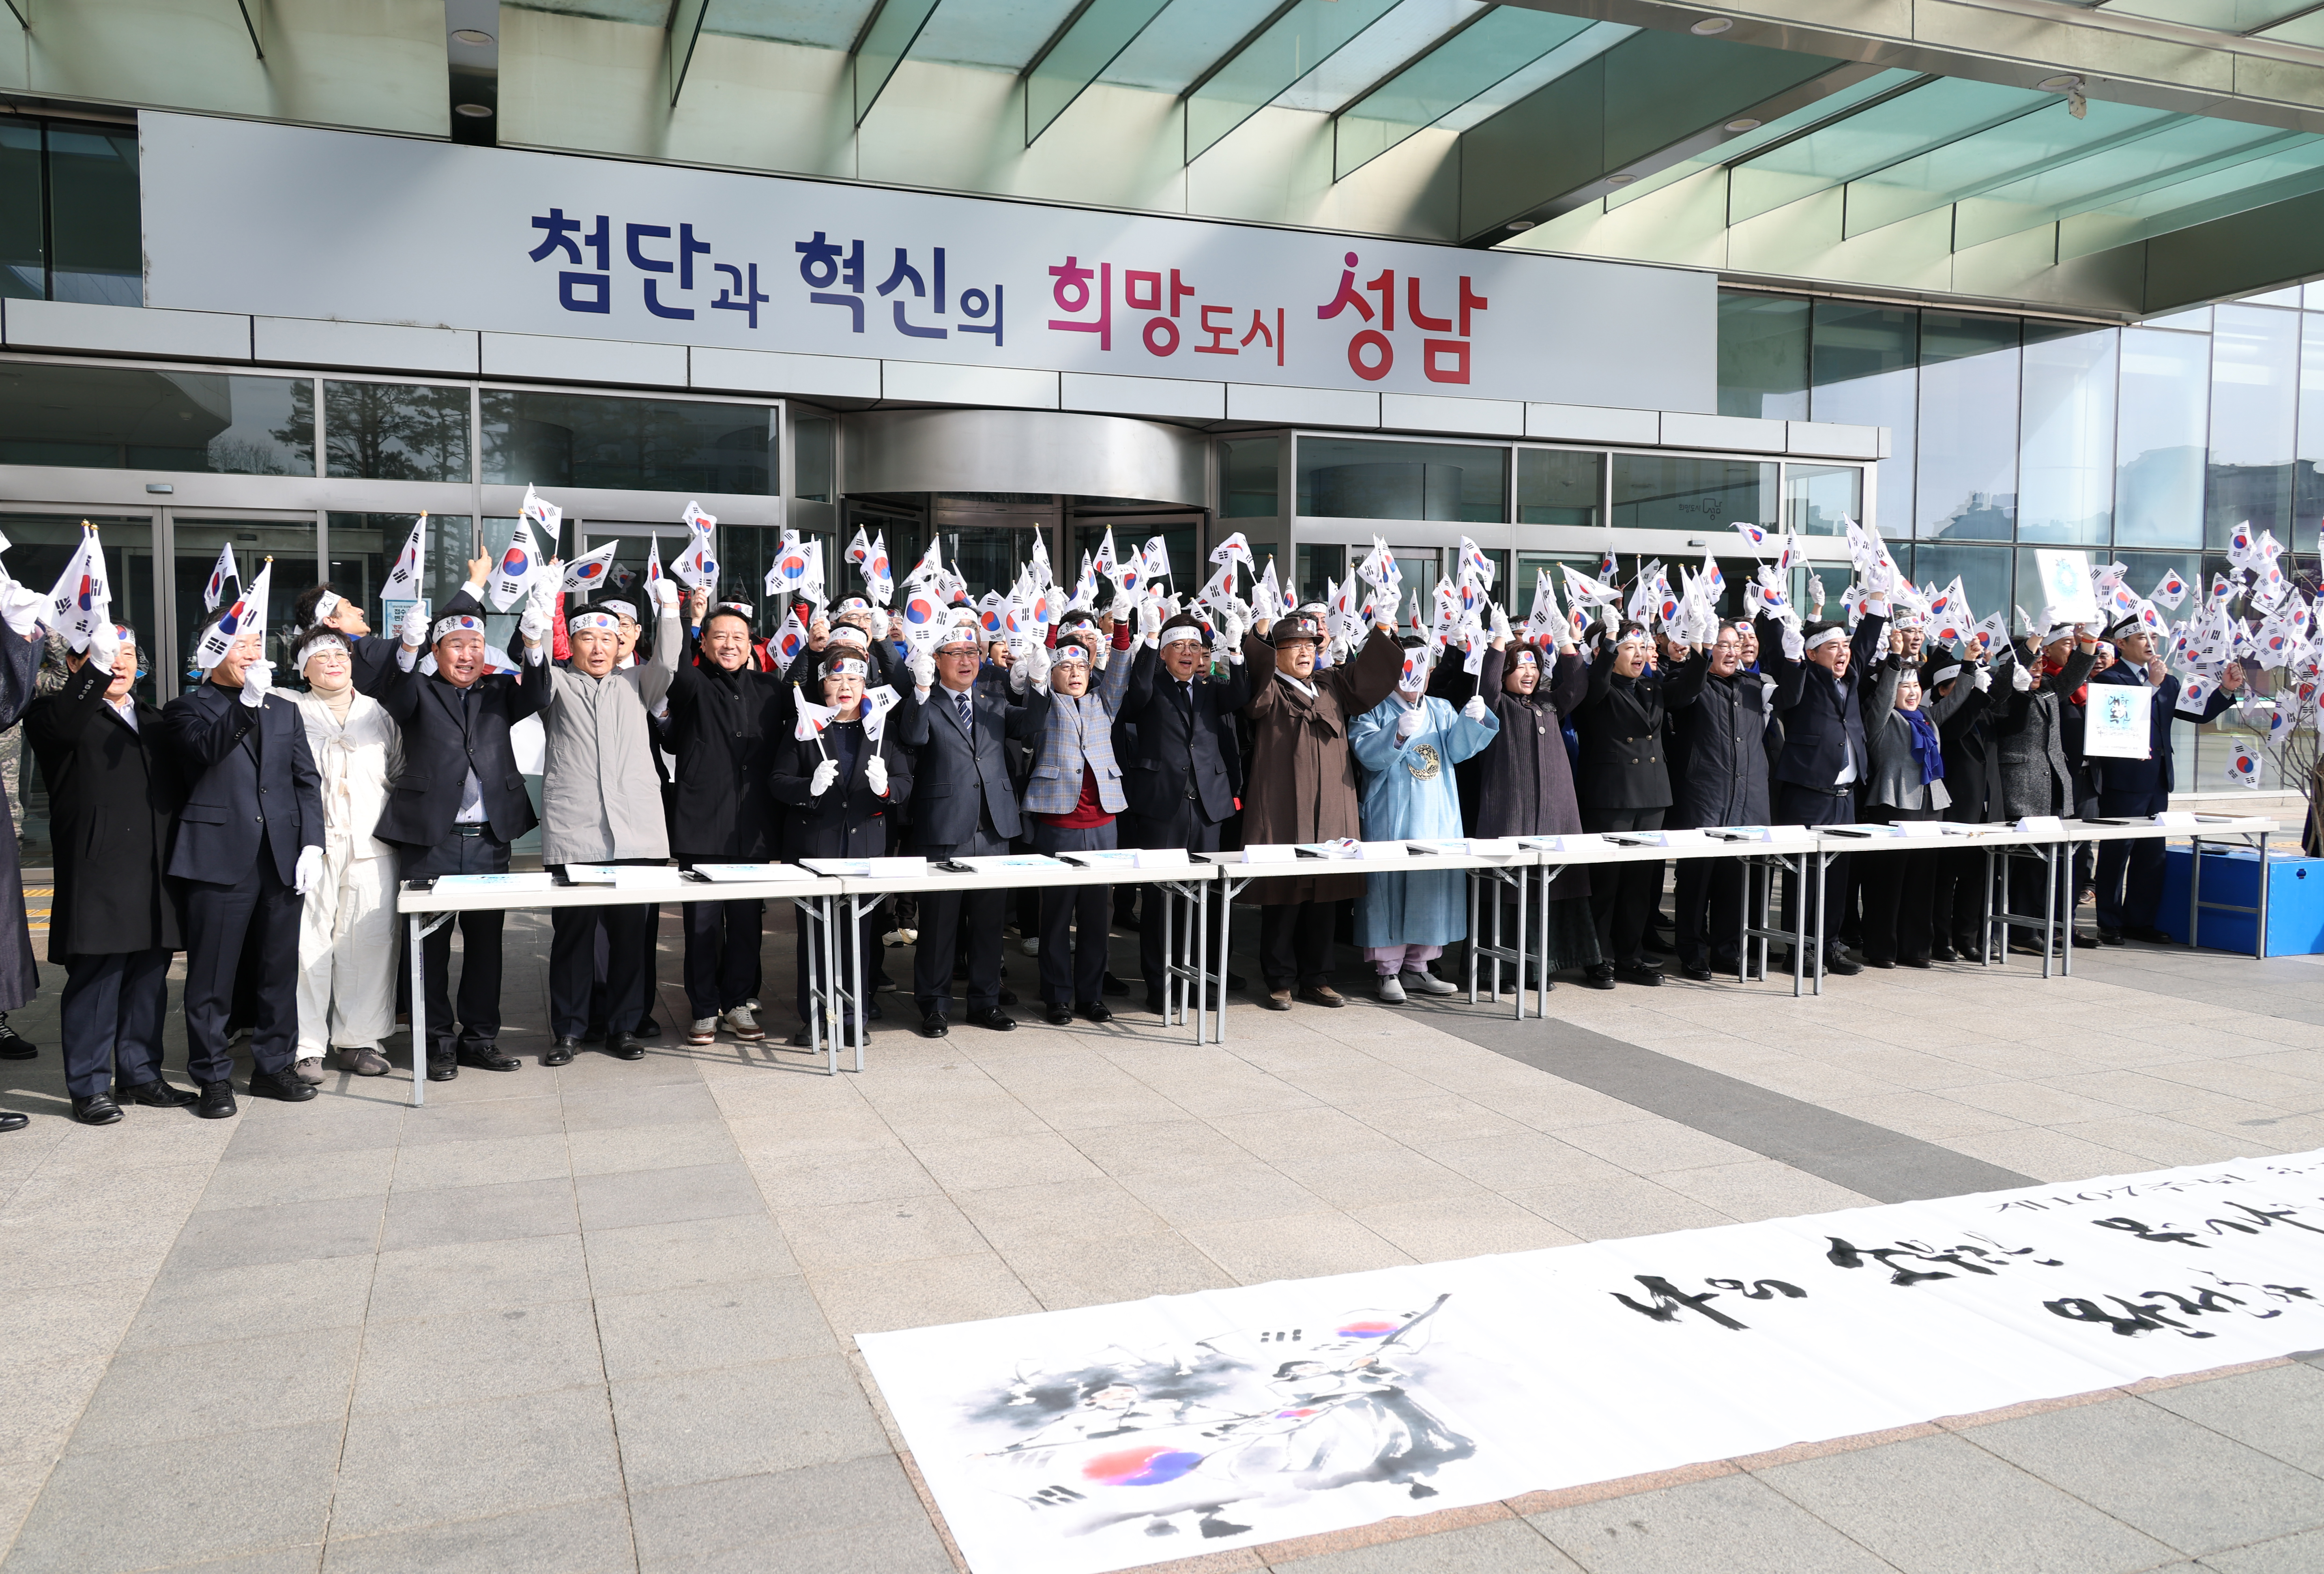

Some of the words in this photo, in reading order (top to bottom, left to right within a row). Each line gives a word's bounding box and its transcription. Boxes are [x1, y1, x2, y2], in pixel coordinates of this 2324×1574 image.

[529, 208, 769, 328] 첨단과
[796, 232, 1002, 346] 혁신의
[1049, 257, 1284, 366] 희망도시
[1318, 251, 1487, 384] 성남
[835, 601, 851, 617] 大韓
[437, 617, 457, 637] 大韓
[572, 615, 593, 631] 大韓
[1059, 621, 1074, 638] 大韓
[2123, 623, 2142, 636] 大韓
[941, 630, 962, 644] 大韓
[848, 662, 864, 674] 獨立
[1985, 1174, 2257, 1213] 제107주년
